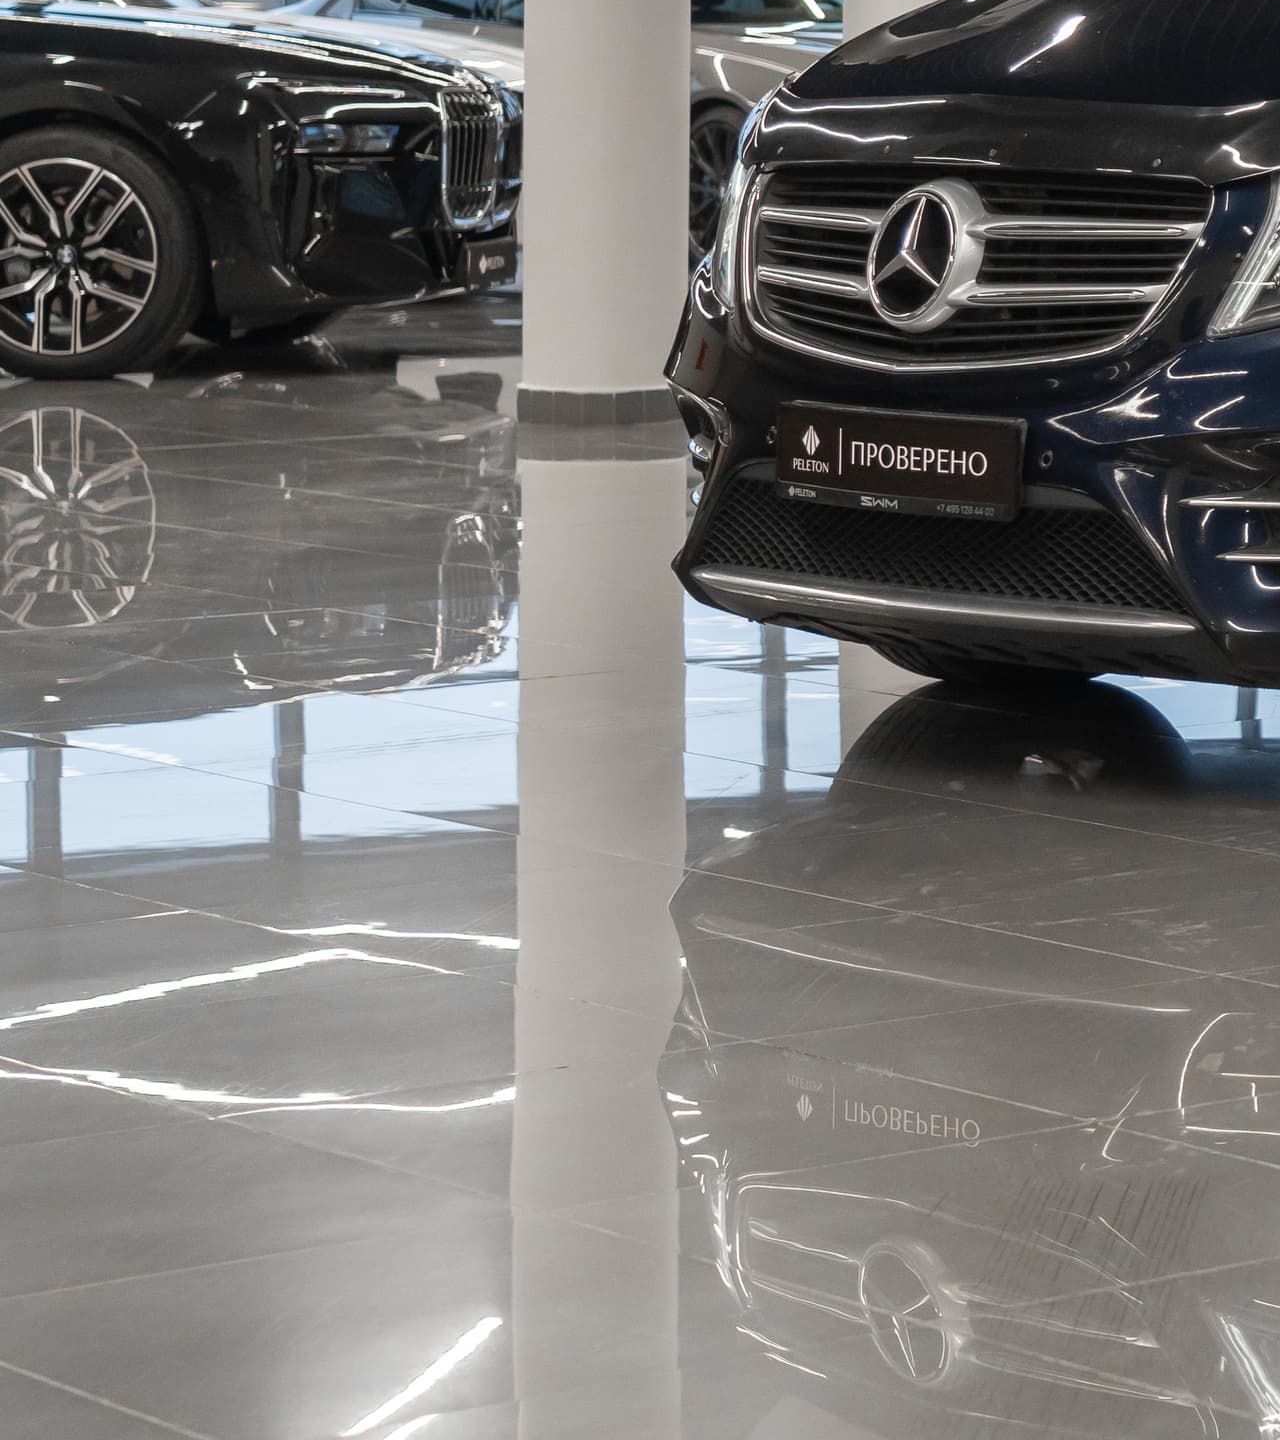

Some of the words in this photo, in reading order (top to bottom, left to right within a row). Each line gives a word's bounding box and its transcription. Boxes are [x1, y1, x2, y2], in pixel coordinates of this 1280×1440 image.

[792, 457, 829, 472] PELETON
[851, 441, 988, 476] ПРОВЕРЕНО
[861, 495, 898, 509] SWM
